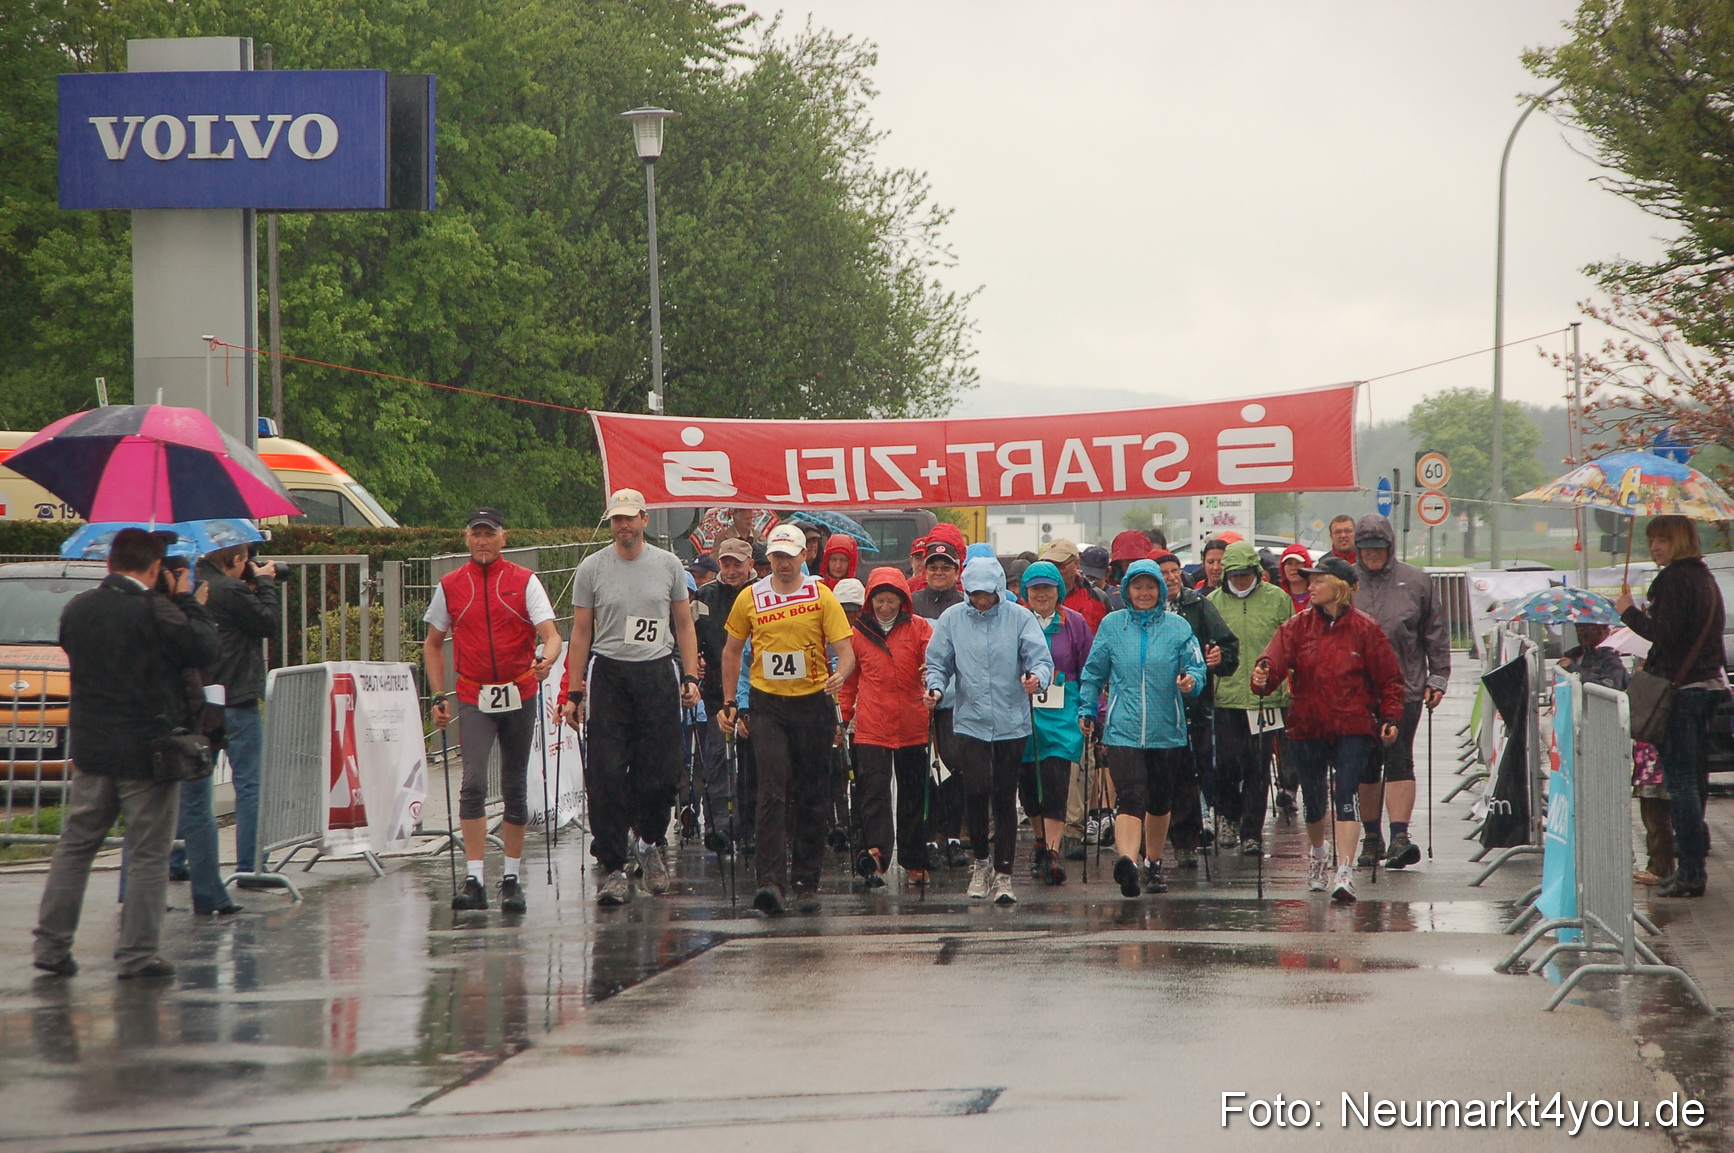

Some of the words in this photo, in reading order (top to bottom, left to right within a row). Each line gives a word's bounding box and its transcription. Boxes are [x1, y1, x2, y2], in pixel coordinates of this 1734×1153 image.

[88, 113, 340, 161] VOLVO
[1425, 463, 1443, 479] 60
[757, 611, 787, 626] MAX
[790, 603, 822, 618] BÖGL
[634, 618, 658, 643] 25
[771, 654, 797, 676] 24
[490, 686, 511, 709] 21
